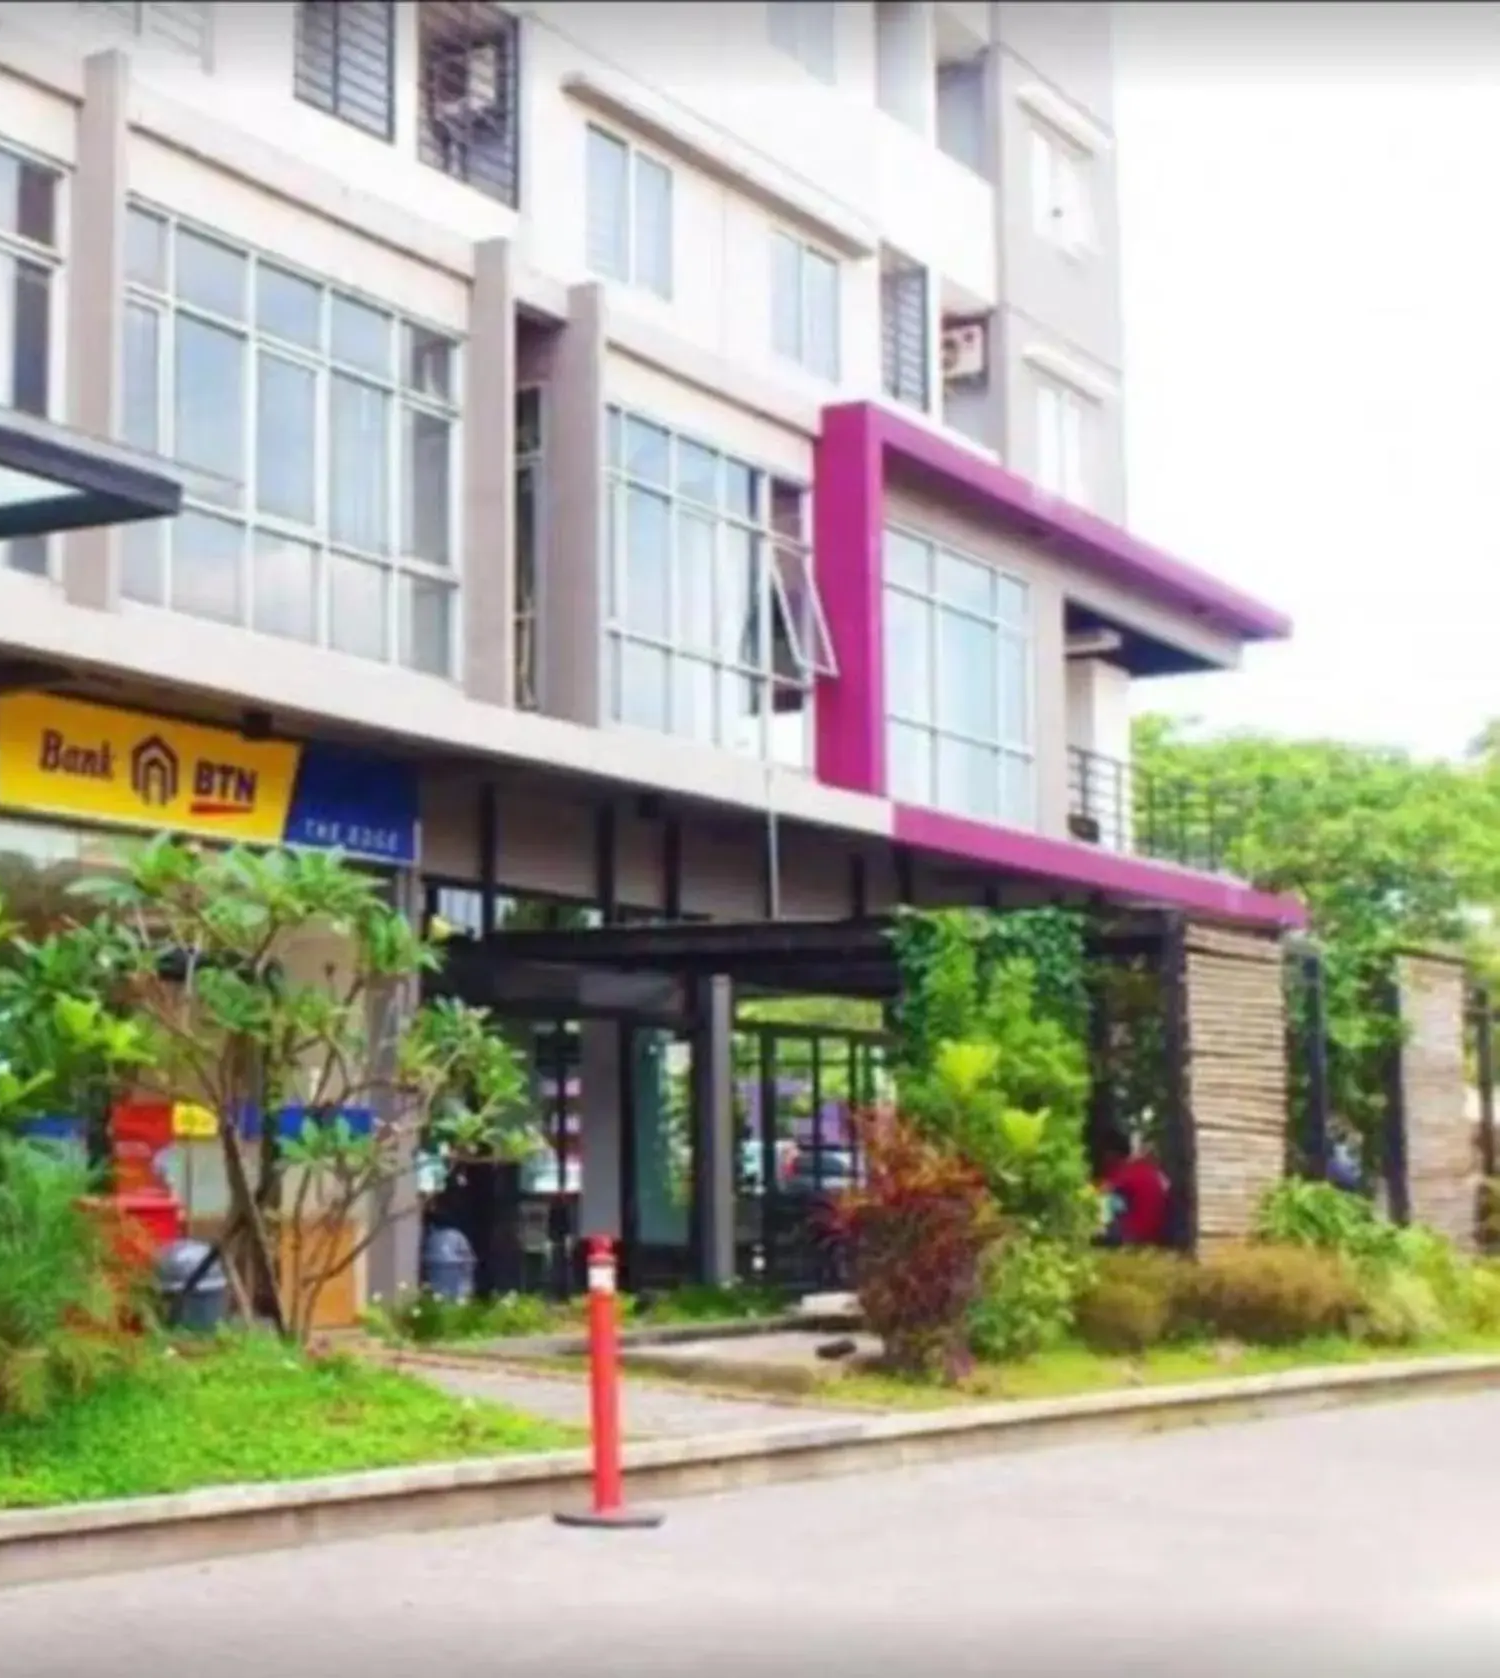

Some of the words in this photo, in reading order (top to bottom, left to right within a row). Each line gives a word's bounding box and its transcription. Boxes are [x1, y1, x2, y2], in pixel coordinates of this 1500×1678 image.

[40, 728, 115, 782] Bank
[192, 757, 258, 803] BTN
[304, 817, 341, 842] THE
